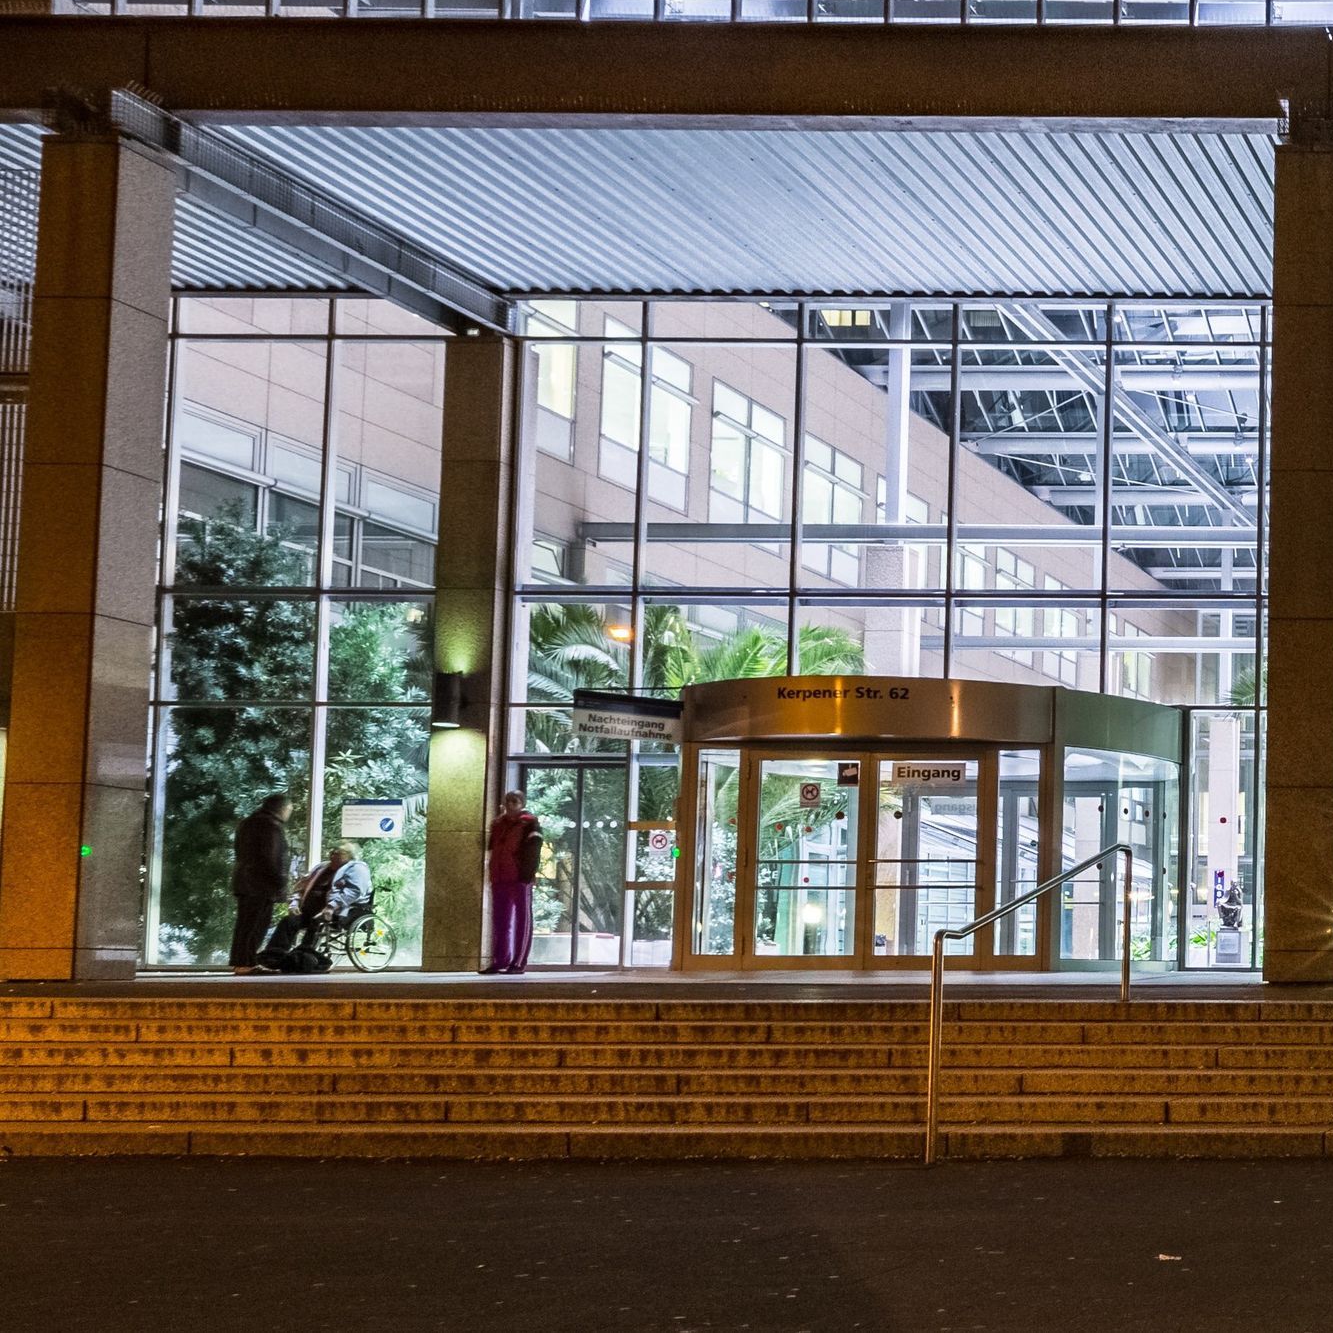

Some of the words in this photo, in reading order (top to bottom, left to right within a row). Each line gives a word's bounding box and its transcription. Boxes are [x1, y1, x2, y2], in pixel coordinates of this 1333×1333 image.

[777, 687, 850, 701] Kerpener
[855, 687, 883, 699] Str.
[889, 687, 909, 700] 62
[588, 713, 665, 731] Nachteingang
[578, 723, 672, 741] Notfallaufnahme
[897, 766, 961, 781] Eingang
